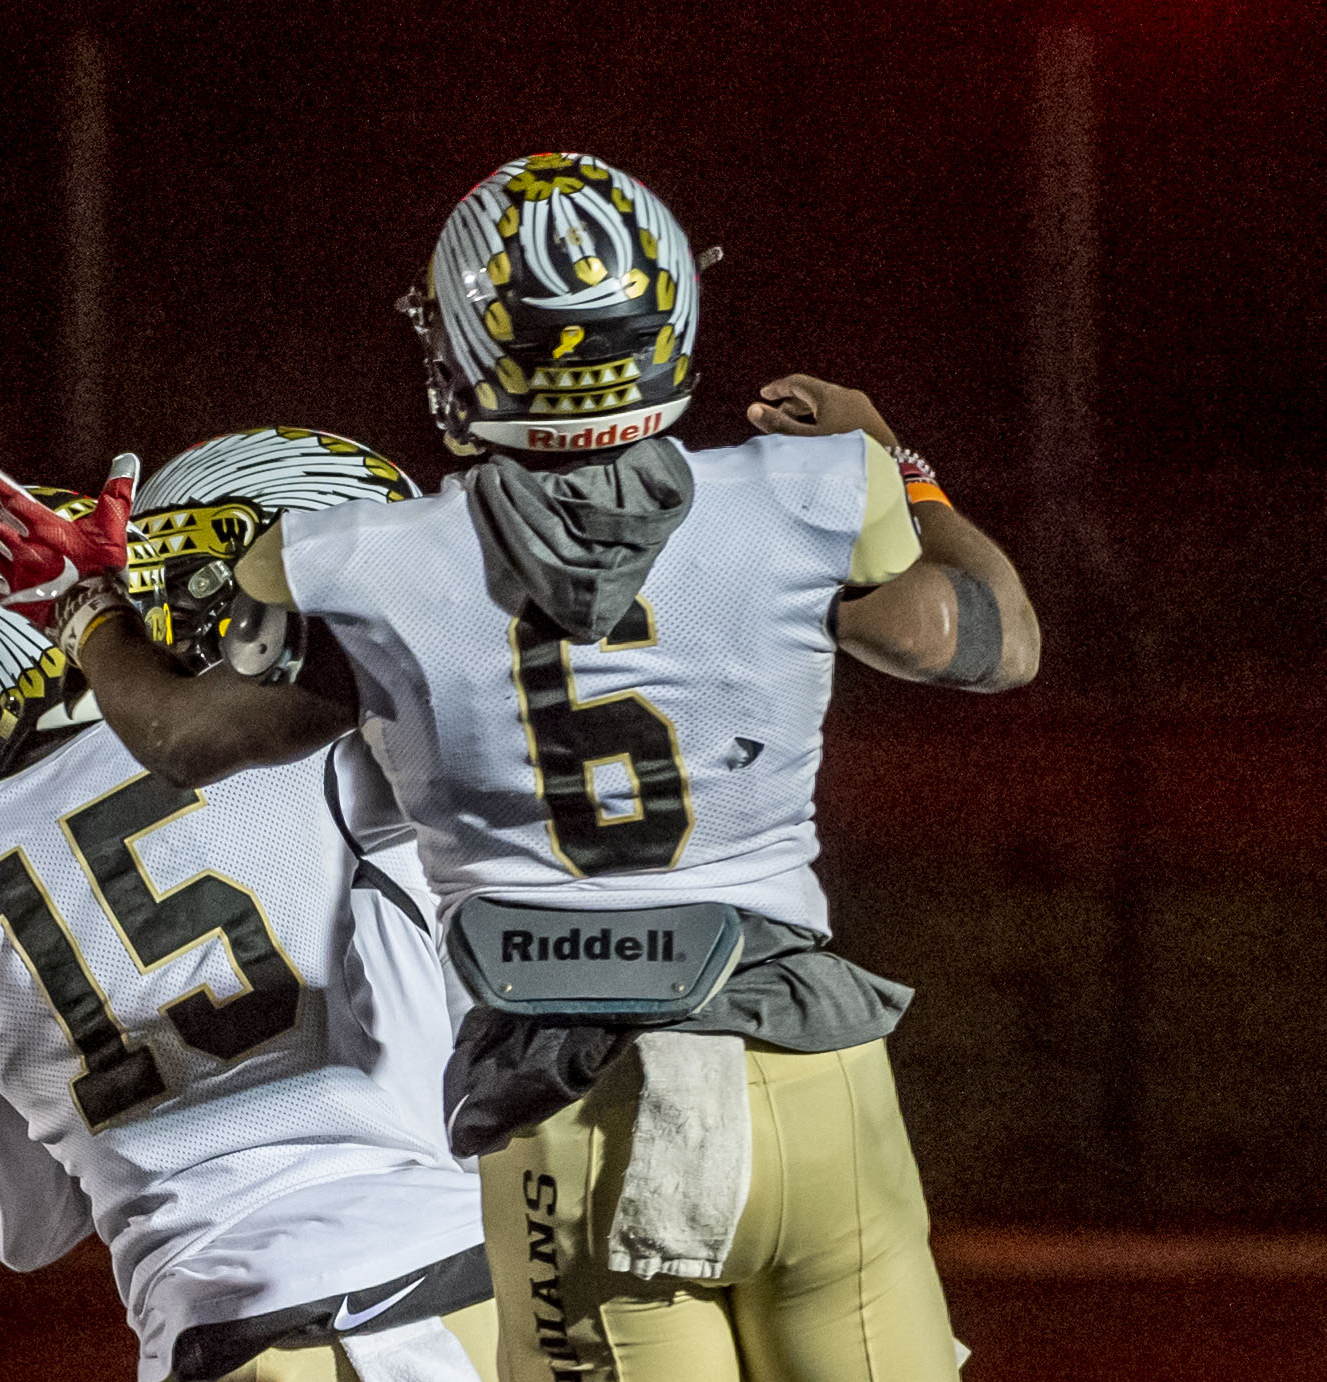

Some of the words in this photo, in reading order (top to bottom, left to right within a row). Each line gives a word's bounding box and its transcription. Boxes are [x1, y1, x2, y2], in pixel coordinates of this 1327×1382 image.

[528, 411, 663, 449] Riddell
[509, 595, 695, 878] 6
[501, 927, 675, 963] Riddell
